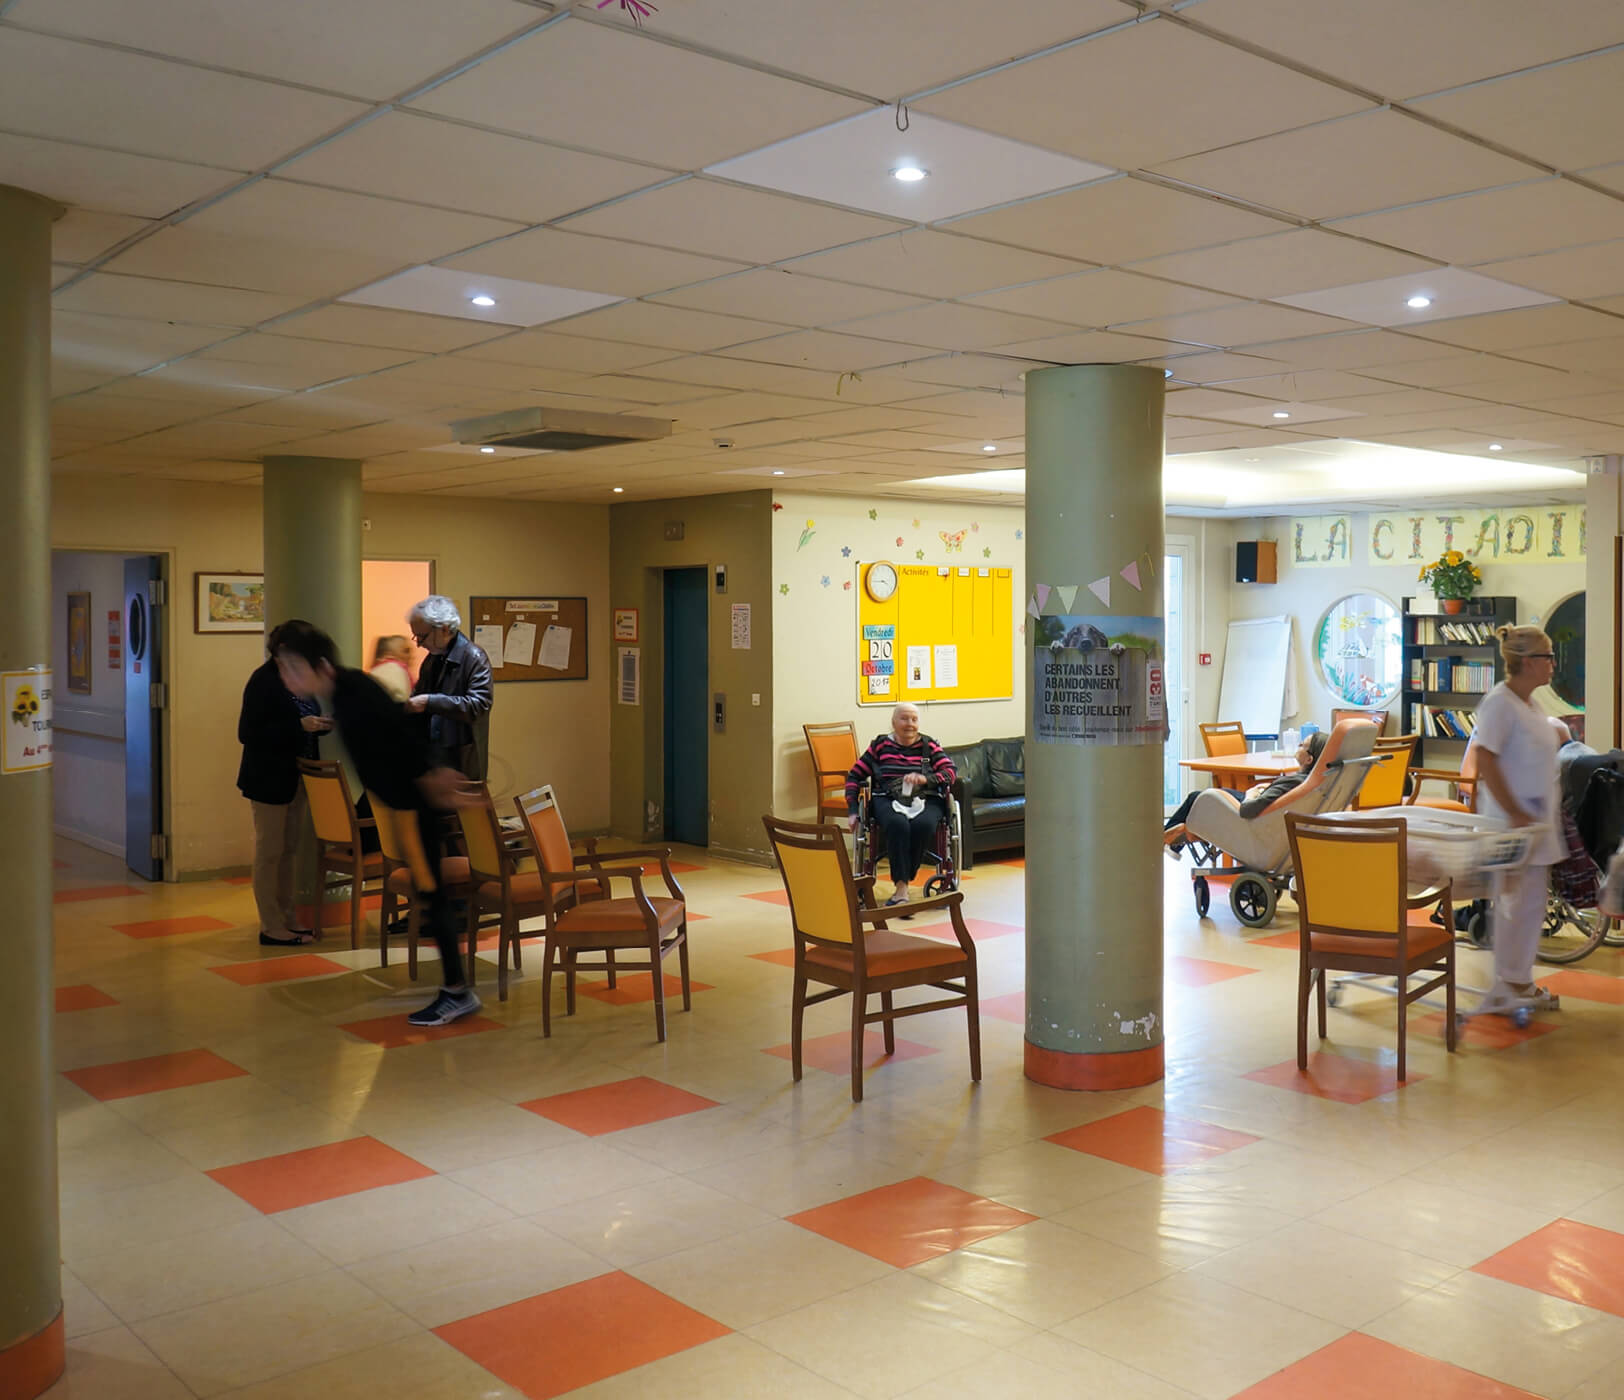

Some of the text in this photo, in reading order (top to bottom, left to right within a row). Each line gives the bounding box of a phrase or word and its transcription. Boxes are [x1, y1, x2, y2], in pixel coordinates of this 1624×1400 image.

[1294, 509, 1587, 562] LA CITADI
[902, 567, 929, 576] Activités
[865, 627, 893, 638] Vendredi
[872, 641, 893, 658] 20
[865, 663, 892, 673] Octobre
[1045, 664, 1115, 676] CERTAINS LES
[871, 678, 889, 687] 2017
[1045, 678, 1120, 690] ABANDONNENT
[1150, 669, 1162, 695] 30
[1045, 704, 1132, 716] LES RECUEILLENT
